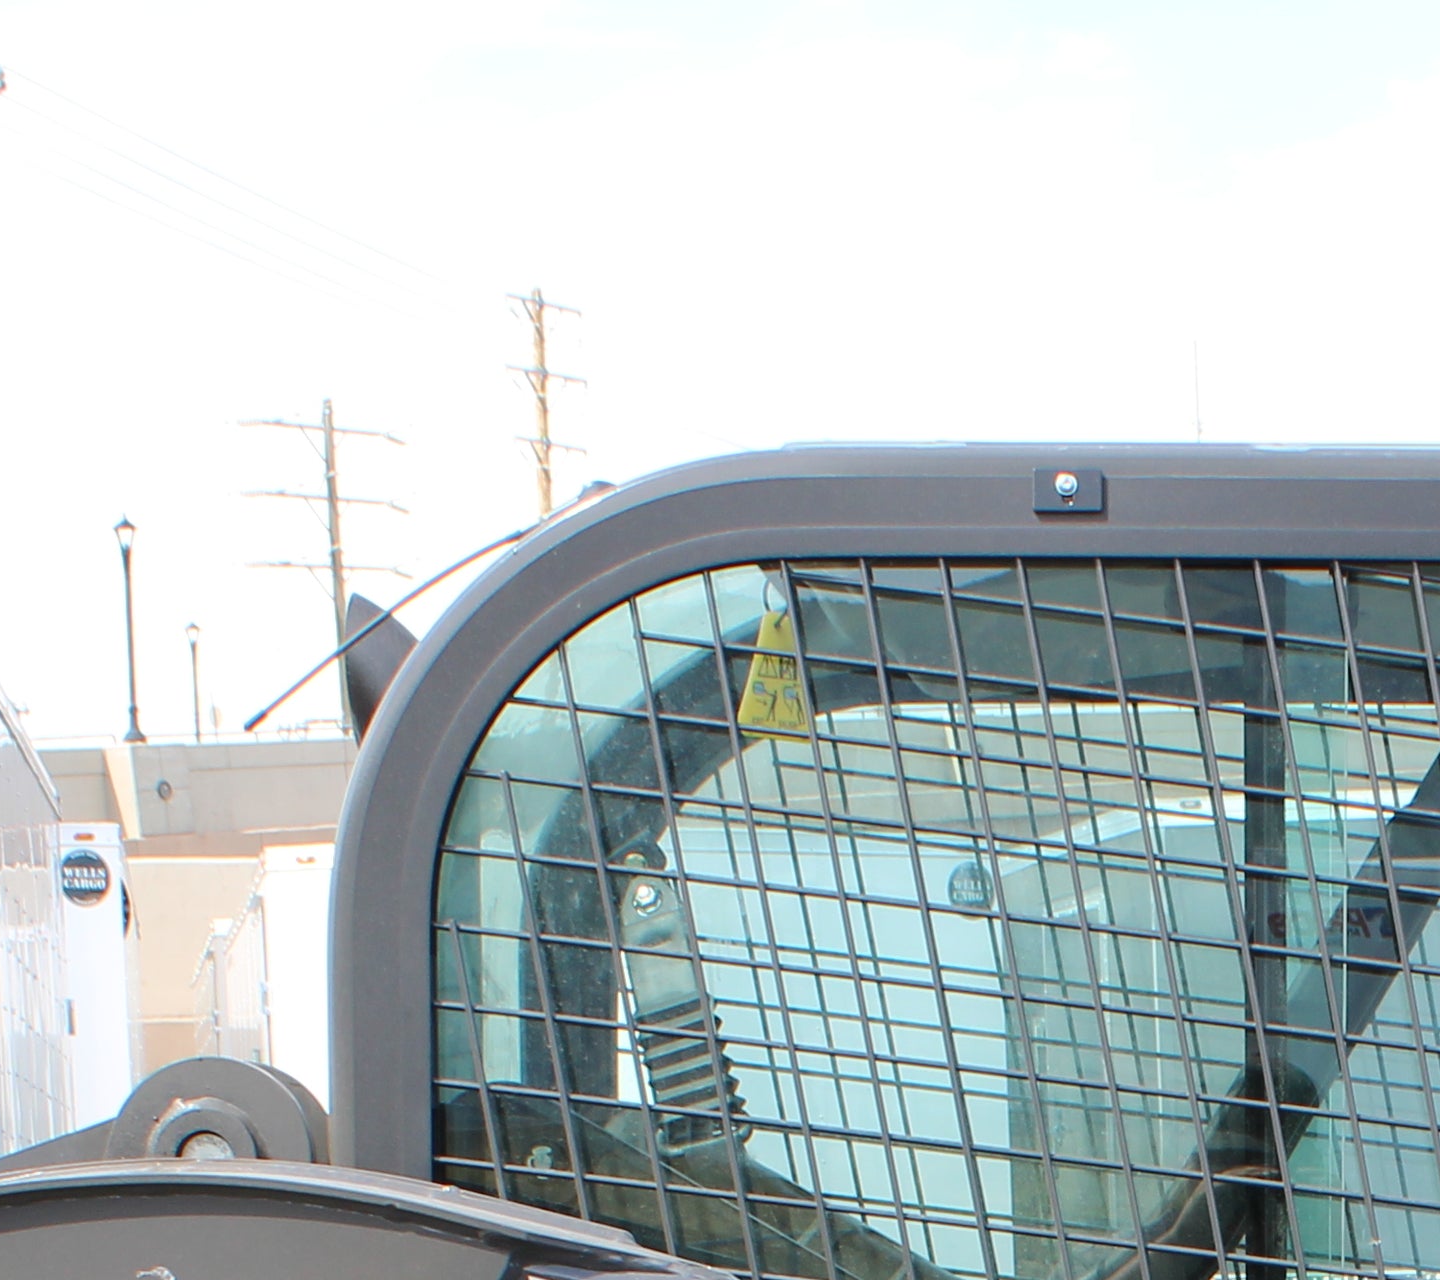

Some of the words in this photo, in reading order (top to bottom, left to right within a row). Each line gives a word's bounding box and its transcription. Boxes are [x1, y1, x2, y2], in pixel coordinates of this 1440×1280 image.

[63, 866, 106, 878] WELLS
[63, 878, 106, 890] CARGO
[953, 879, 991, 890] WELL
